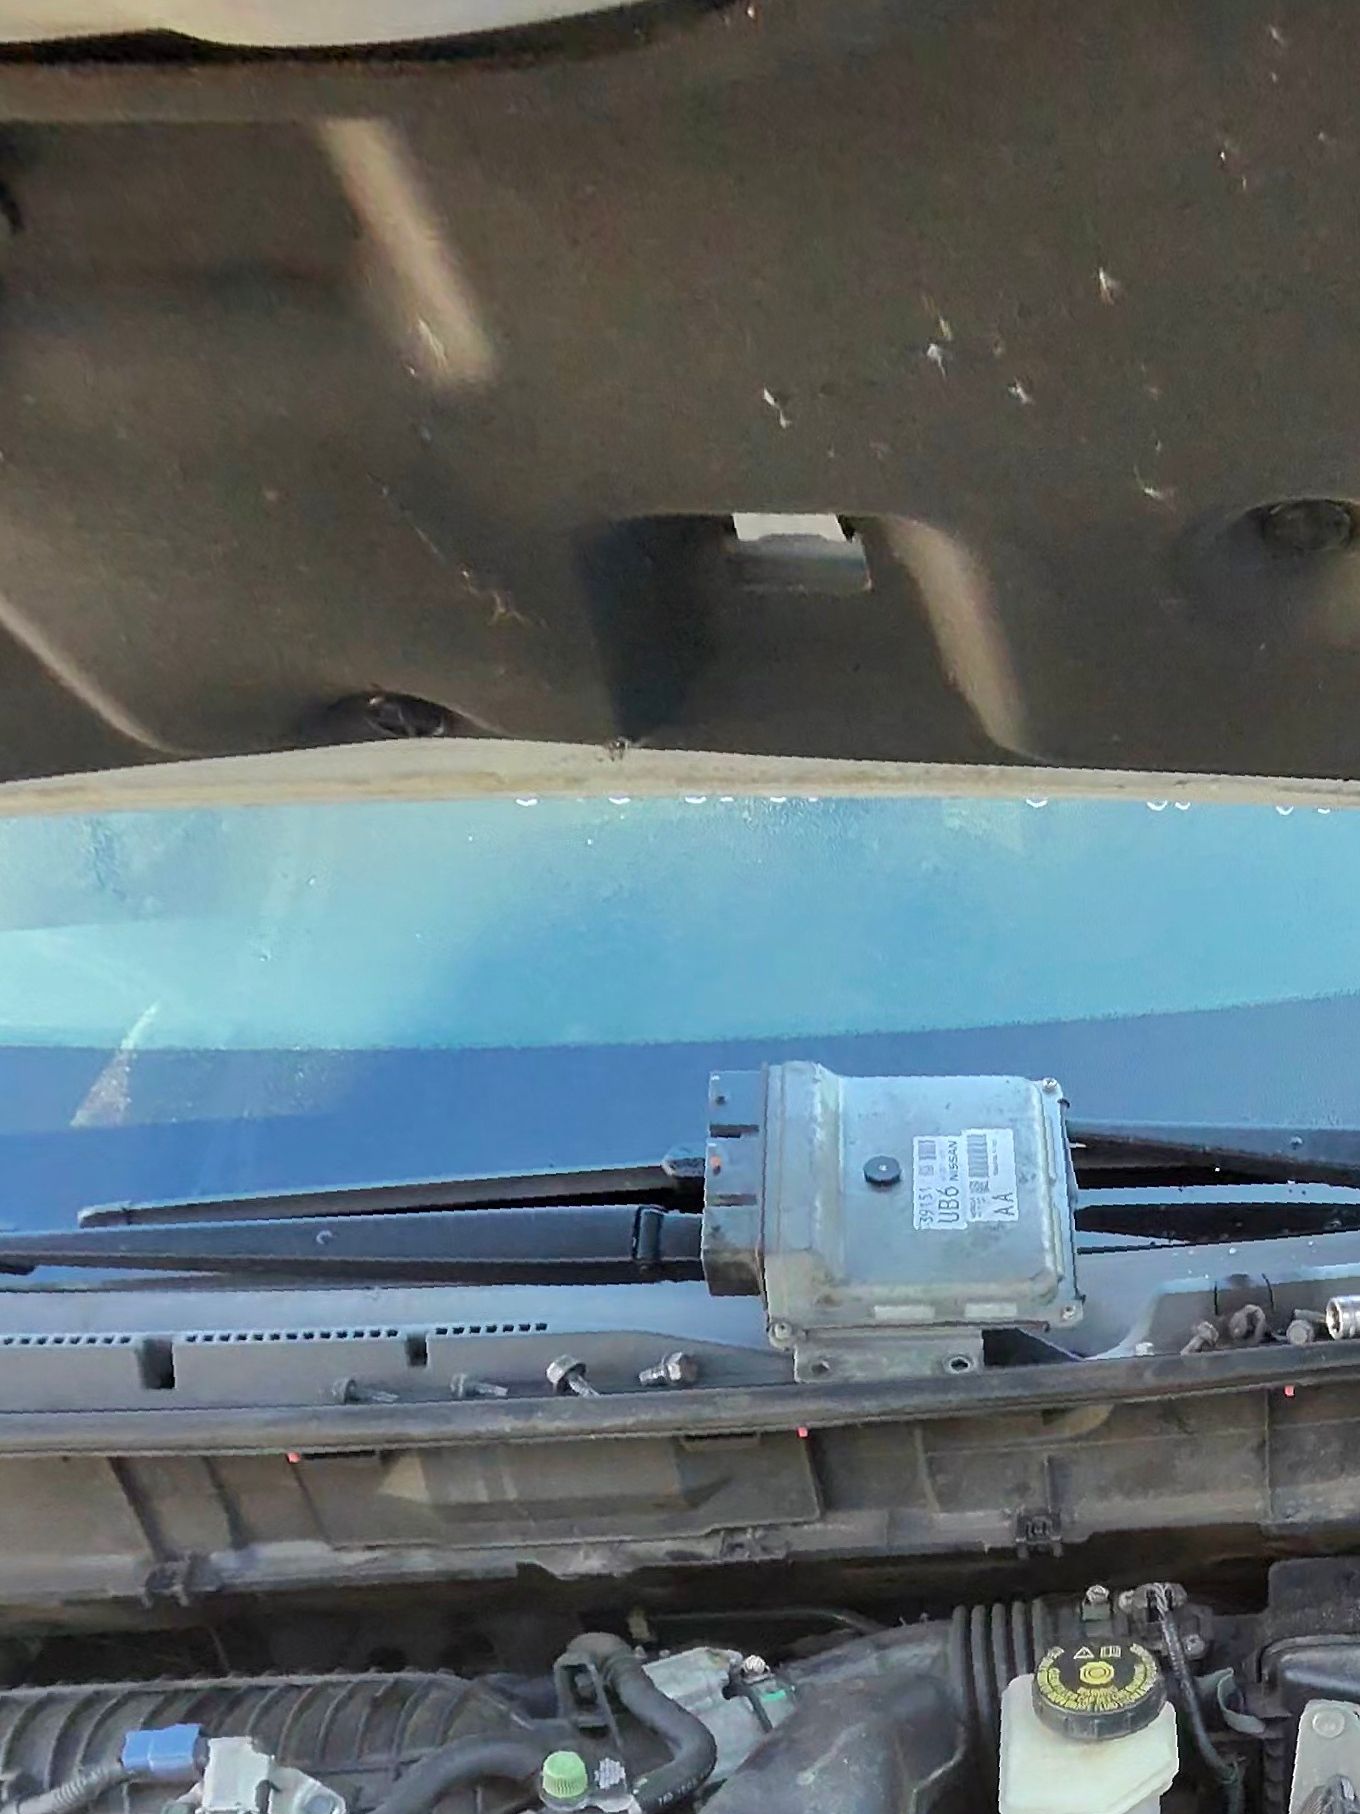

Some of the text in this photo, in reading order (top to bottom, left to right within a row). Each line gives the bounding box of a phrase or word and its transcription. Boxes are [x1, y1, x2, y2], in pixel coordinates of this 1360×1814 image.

[919, 1186, 934, 1225] 39151
[935, 1140, 960, 1224] UB6 NISSAN
